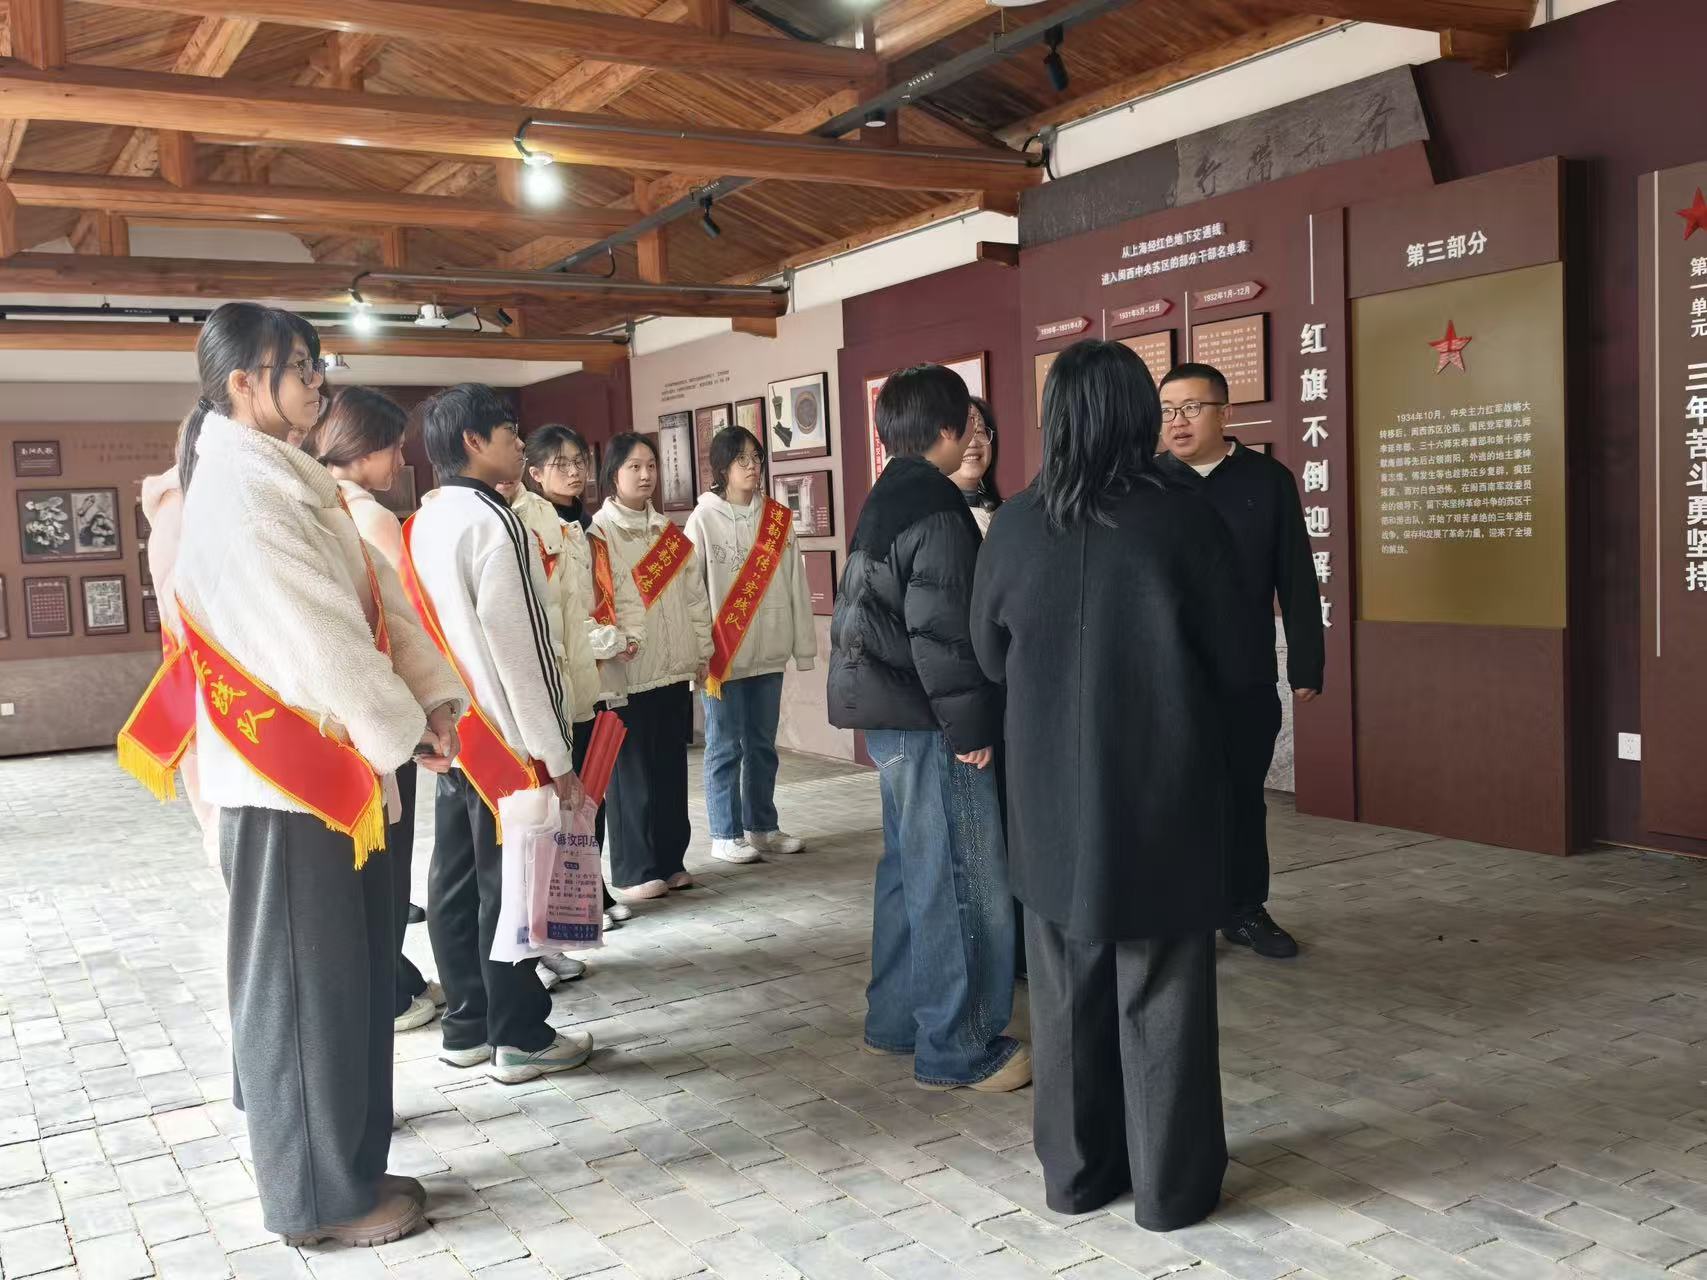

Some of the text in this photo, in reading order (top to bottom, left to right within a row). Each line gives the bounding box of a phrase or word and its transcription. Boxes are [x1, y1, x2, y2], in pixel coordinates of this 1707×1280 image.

[1101, 240, 1250, 286] 进入闽西中央苏区的部分干部名单表
[1121, 222, 1224, 259] 从上海经红色地下交通线
[1405, 230, 1488, 268] 第三部分
[1690, 256, 1707, 338] 第一单元
[1684, 362, 1707, 591] 三年苦斗勇坚持
